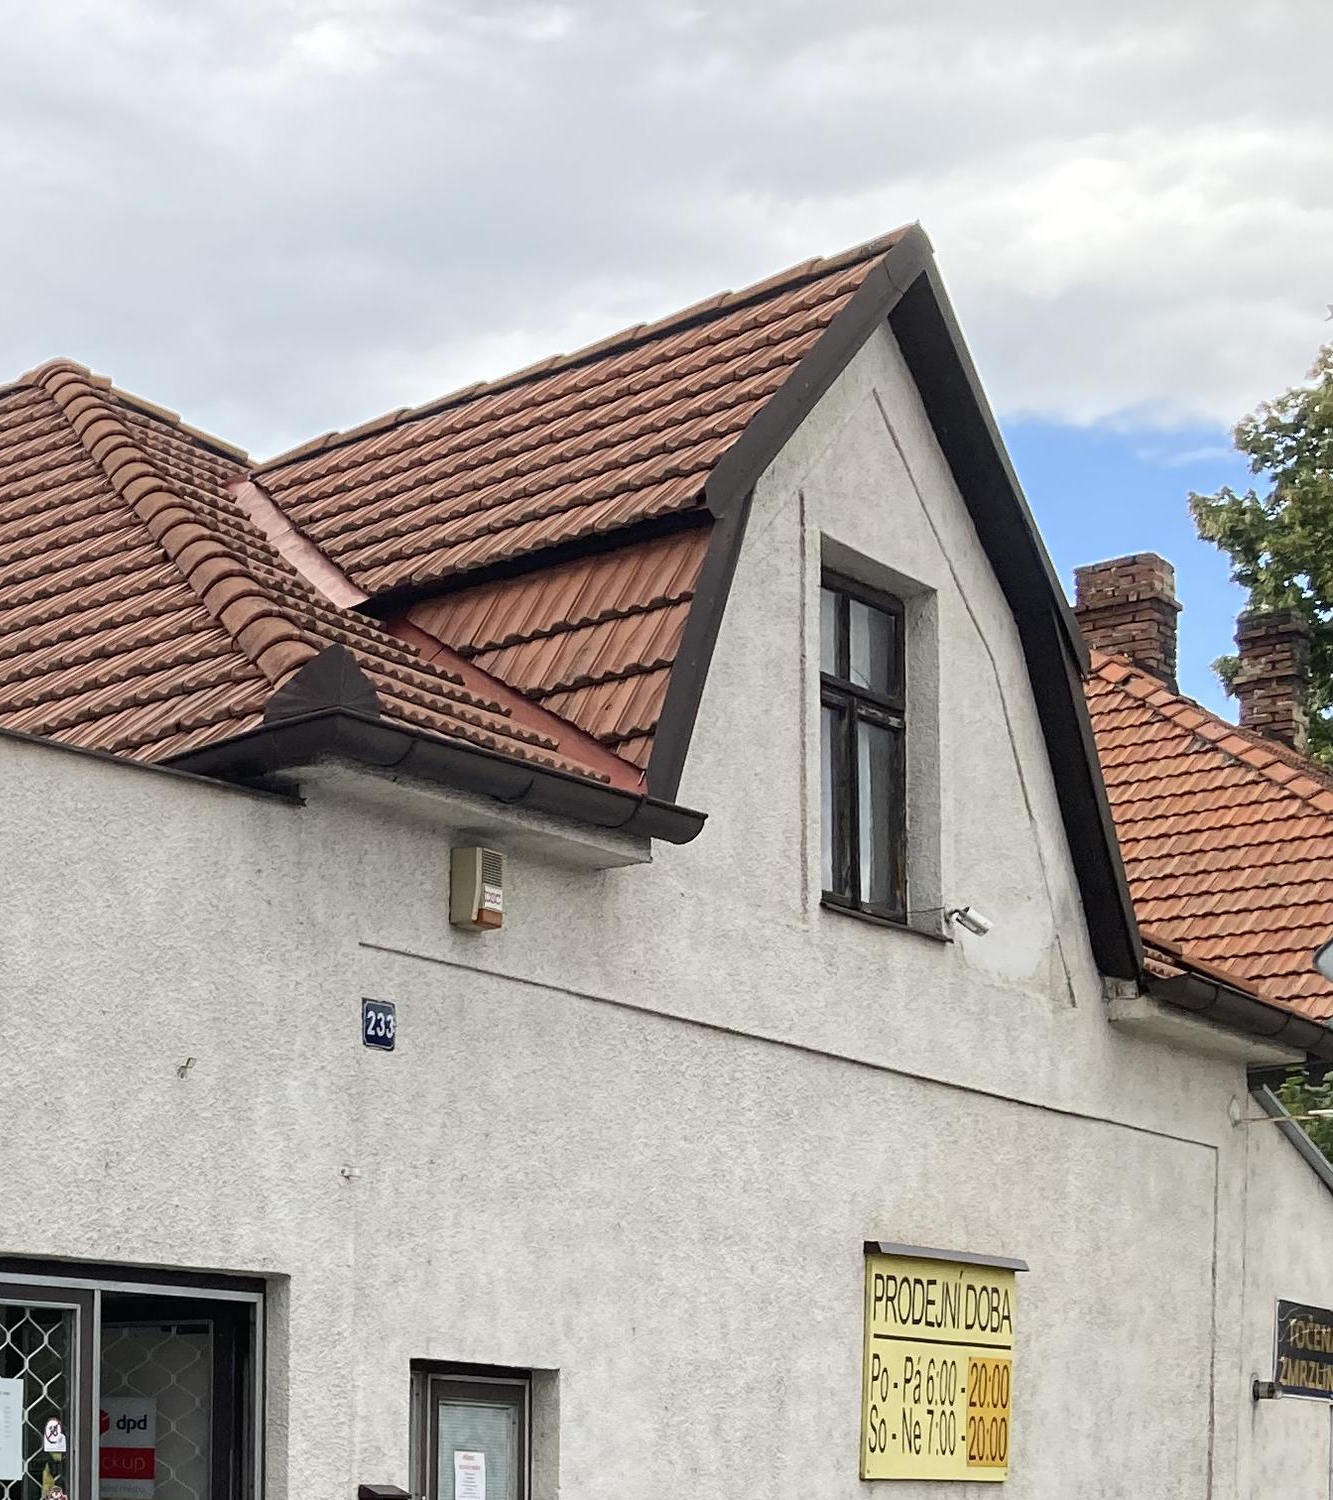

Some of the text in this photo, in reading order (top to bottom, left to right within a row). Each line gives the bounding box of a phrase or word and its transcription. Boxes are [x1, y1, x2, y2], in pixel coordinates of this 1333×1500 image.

[366, 1010, 393, 1038] 233
[873, 1271, 1013, 1334] PRODEJNÍ DOBA
[871, 1353, 889, 1402] Po
[903, 1356, 922, 1404] Pá
[926, 1358, 957, 1406] 6:00
[969, 1362, 1010, 1409] 20:00
[116, 1414, 148, 1434] dpd
[868, 1404, 887, 1453] So
[902, 1407, 922, 1456] Ne
[926, 1409, 957, 1456] 7:00
[968, 1416, 1008, 1462] 20:00
[101, 1454, 146, 1474] ckup
